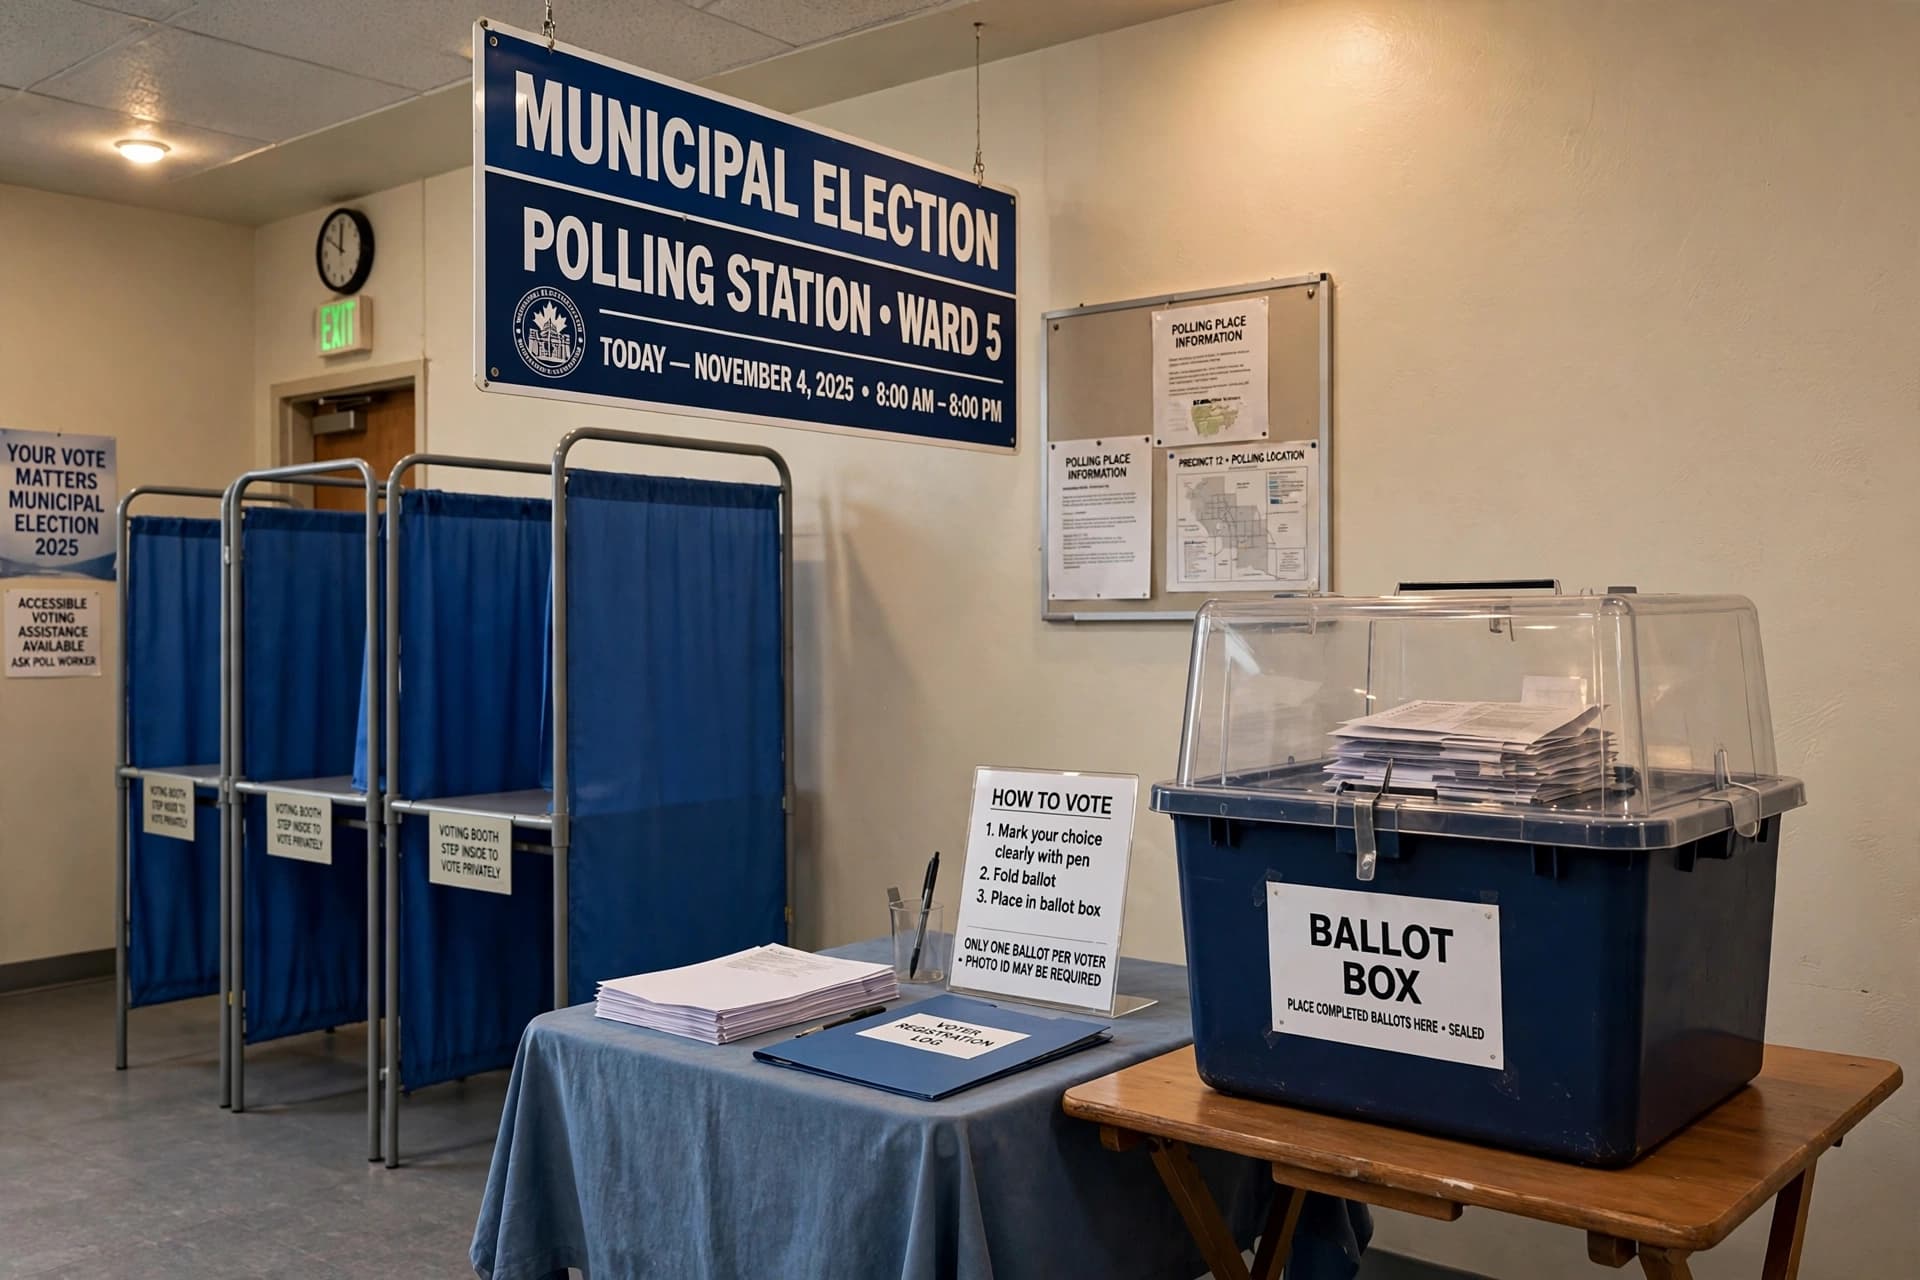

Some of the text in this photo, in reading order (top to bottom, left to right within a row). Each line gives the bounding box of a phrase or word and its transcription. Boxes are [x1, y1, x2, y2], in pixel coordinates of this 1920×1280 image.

[515, 70, 999, 271] MUNICIPAL ELECTION
[522, 206, 714, 306] POLLING
[727, 253, 871, 336] STATION
[897, 291, 979, 357] WARD
[986, 314, 1001, 361] 5
[320, 300, 357, 352] EXIT
[1172, 315, 1247, 335] POLLING PLACE
[1176, 330, 1243, 348] INFORMATION
[599, 336, 666, 374] TODAY
[694, 351, 792, 392] NOVEMBER
[796, 369, 812, 401] 4,
[816, 371, 854, 401] 2025
[876, 381, 909, 409] 8:00
[912, 388, 934, 413] AM
[949, 393, 979, 420] 8:00
[982, 398, 1002, 423] PM
[7, 443, 106, 469] YOUR VOTE
[1065, 453, 1131, 468] POLLING PLACE
[1178, 456, 1213, 468] PRECINCT
[1216, 456, 1223, 466] 12
[1231, 453, 1265, 465] POLLING
[1266, 450, 1305, 462] LOCATION
[15, 468, 97, 490] MATTERS
[1068, 467, 1127, 480] INFORMATION
[9, 490, 104, 513] MUNICIPAL
[15, 514, 99, 535] ELECTION
[35, 538, 78, 556] 2025
[18, 597, 87, 609] ACCESSIBLE
[32, 611, 75, 623] VOTING
[18, 626, 88, 638] ASSISTANCE
[23, 640, 84, 652] AVAILABLE
[11, 656, 96, 667] ASK POLL WORKER
[275, 803, 322, 818] VOTING BOOTH
[992, 788, 1112, 814] HOW TO VOTE
[277, 819, 292, 830] STEP
[312, 824, 322, 835] TO
[439, 824, 499, 843] VOTING BOOTH
[986, 822, 1103, 846] 1. Mark your choice
[276, 834, 323, 850] VOTE PRIVATELY
[441, 843, 460, 855] STEP
[488, 848, 499, 861] TO
[995, 846, 1090, 869] clearly with pen
[441, 859, 501, 879] VOTE PRIVATELY
[979, 866, 1056, 888] 2. Fold ballot
[976, 889, 1101, 917] 3. Place in ballot box
[1309, 912, 1454, 963] BALLOT
[964, 937, 1106, 969] ONLY ONE BALLOT PER VOTER
[965, 956, 997, 971] PHOTO
[1000, 960, 1009, 973] ID
[1012, 962, 1034, 977] MAY
[1035, 966, 1048, 979] BE
[1050, 968, 1101, 987] REQUIRED
[1343, 961, 1422, 1005] BOX
[937, 1022, 982, 1036] VOTER
[1287, 997, 1314, 1014] PLACE
[1316, 1002, 1369, 1022] COMPLETED
[1371, 1010, 1411, 1030] BALLOTS
[1413, 1017, 1438, 1034] HERE
[1448, 1022, 1485, 1041] SEALED
[895, 1023, 995, 1047] REGISTRATION
[910, 1035, 943, 1046] LOG
